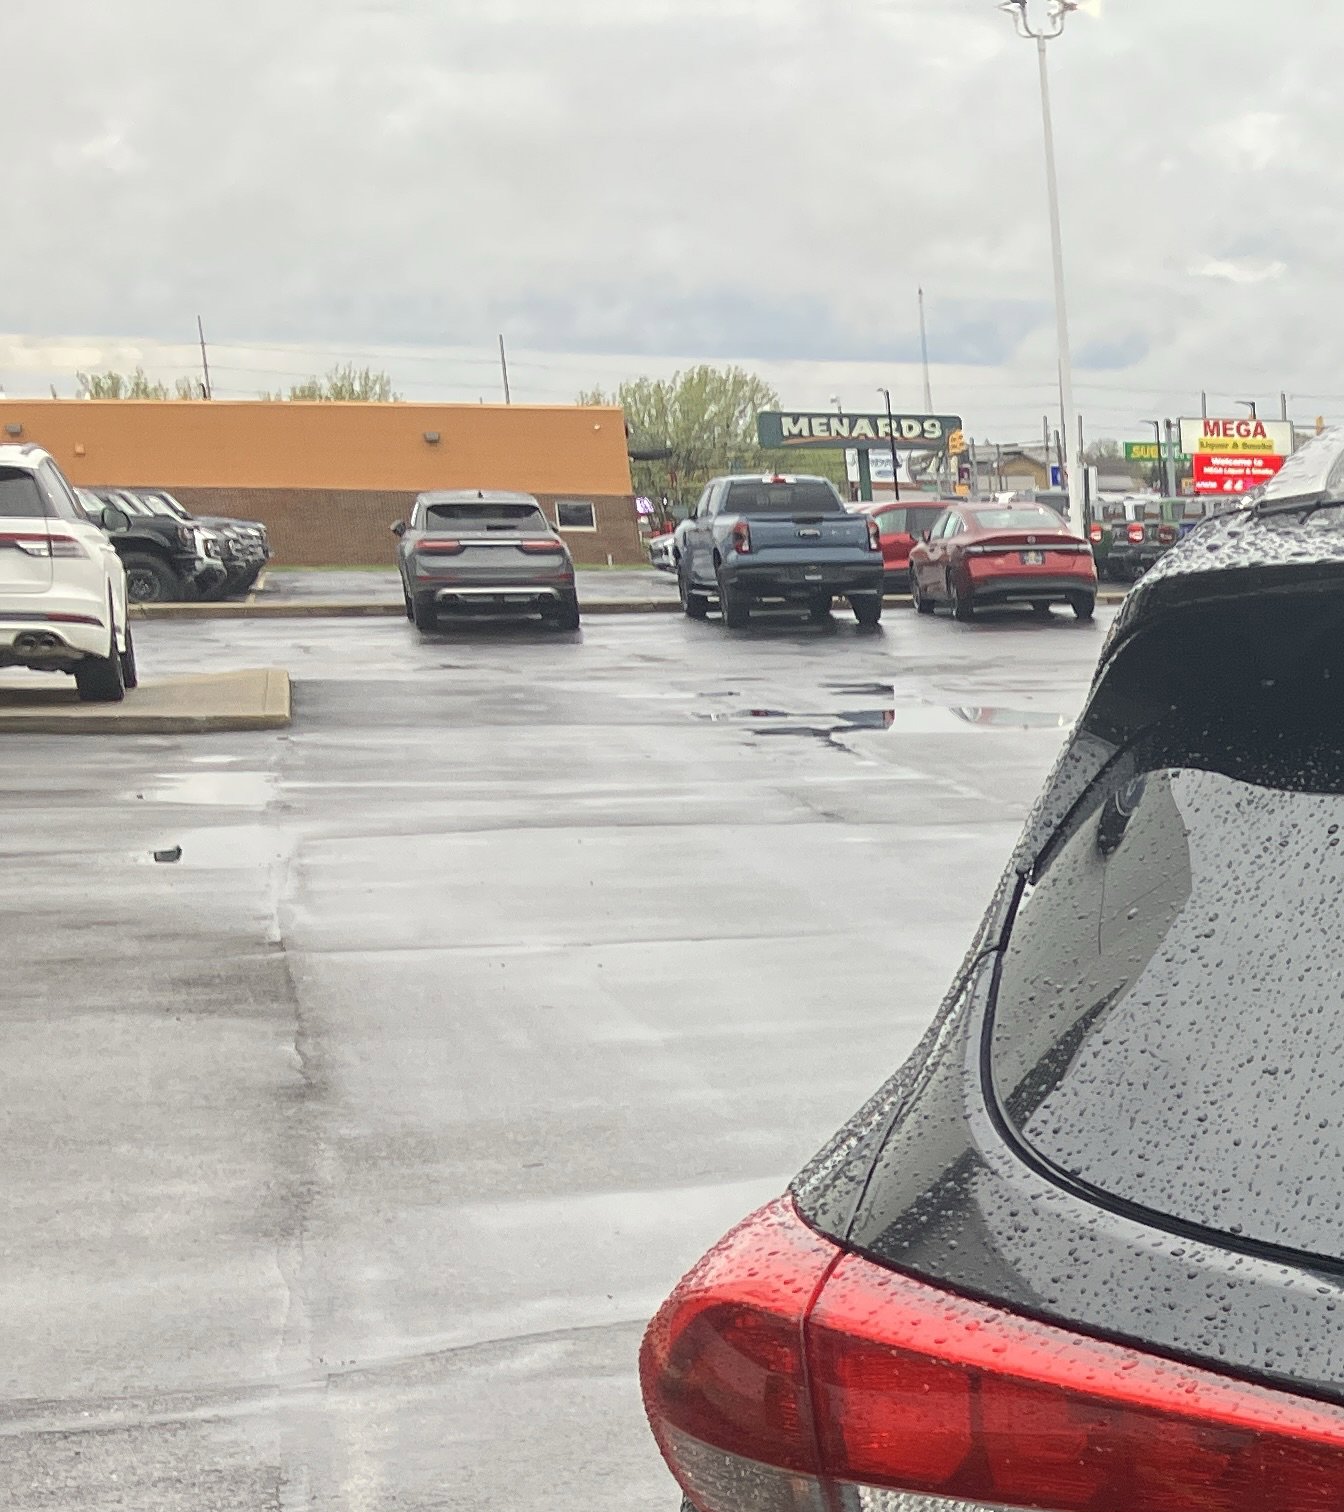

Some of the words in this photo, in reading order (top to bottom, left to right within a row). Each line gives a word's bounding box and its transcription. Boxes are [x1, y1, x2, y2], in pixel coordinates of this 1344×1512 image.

[780, 416, 943, 439] MENARDS
[1203, 420, 1267, 438] MEGA
[1131, 445, 1189, 459] SUBW
